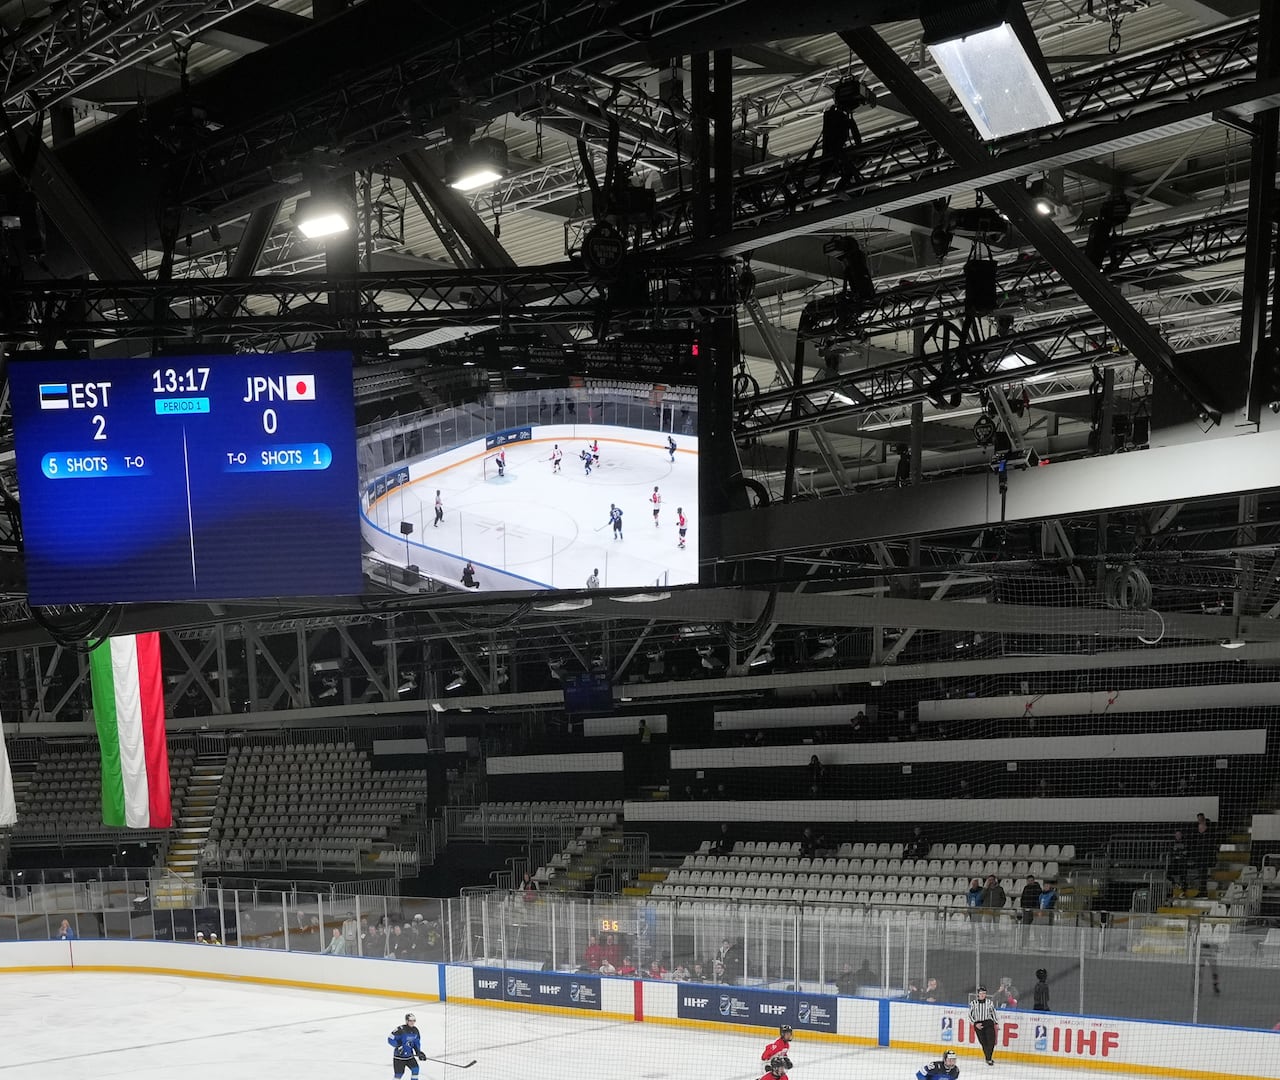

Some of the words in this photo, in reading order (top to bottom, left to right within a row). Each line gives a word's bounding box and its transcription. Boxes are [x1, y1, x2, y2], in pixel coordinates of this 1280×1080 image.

[152, 367, 210, 393] 13:17
[71, 382, 111, 408] EST
[243, 376, 285, 402] JPN
[163, 402, 194, 411] PERIOD
[92, 415, 107, 440] 2
[263, 408, 278, 434] 0
[124, 456, 145, 469] T-O
[227, 453, 247, 464] T-O
[261, 450, 303, 465] SHOTS
[313, 449, 322, 465] 1
[49, 458, 58, 474] 5
[67, 457, 108, 472] SHOTS
[479, 980, 498, 989] IIHF
[540, 985, 561, 994] IIHF
[684, 997, 709, 1008] IIHF
[759, 1004, 787, 1015] IIHF
[958, 1018, 1019, 1047] IIF
[1052, 1027, 1120, 1057] IIHF
